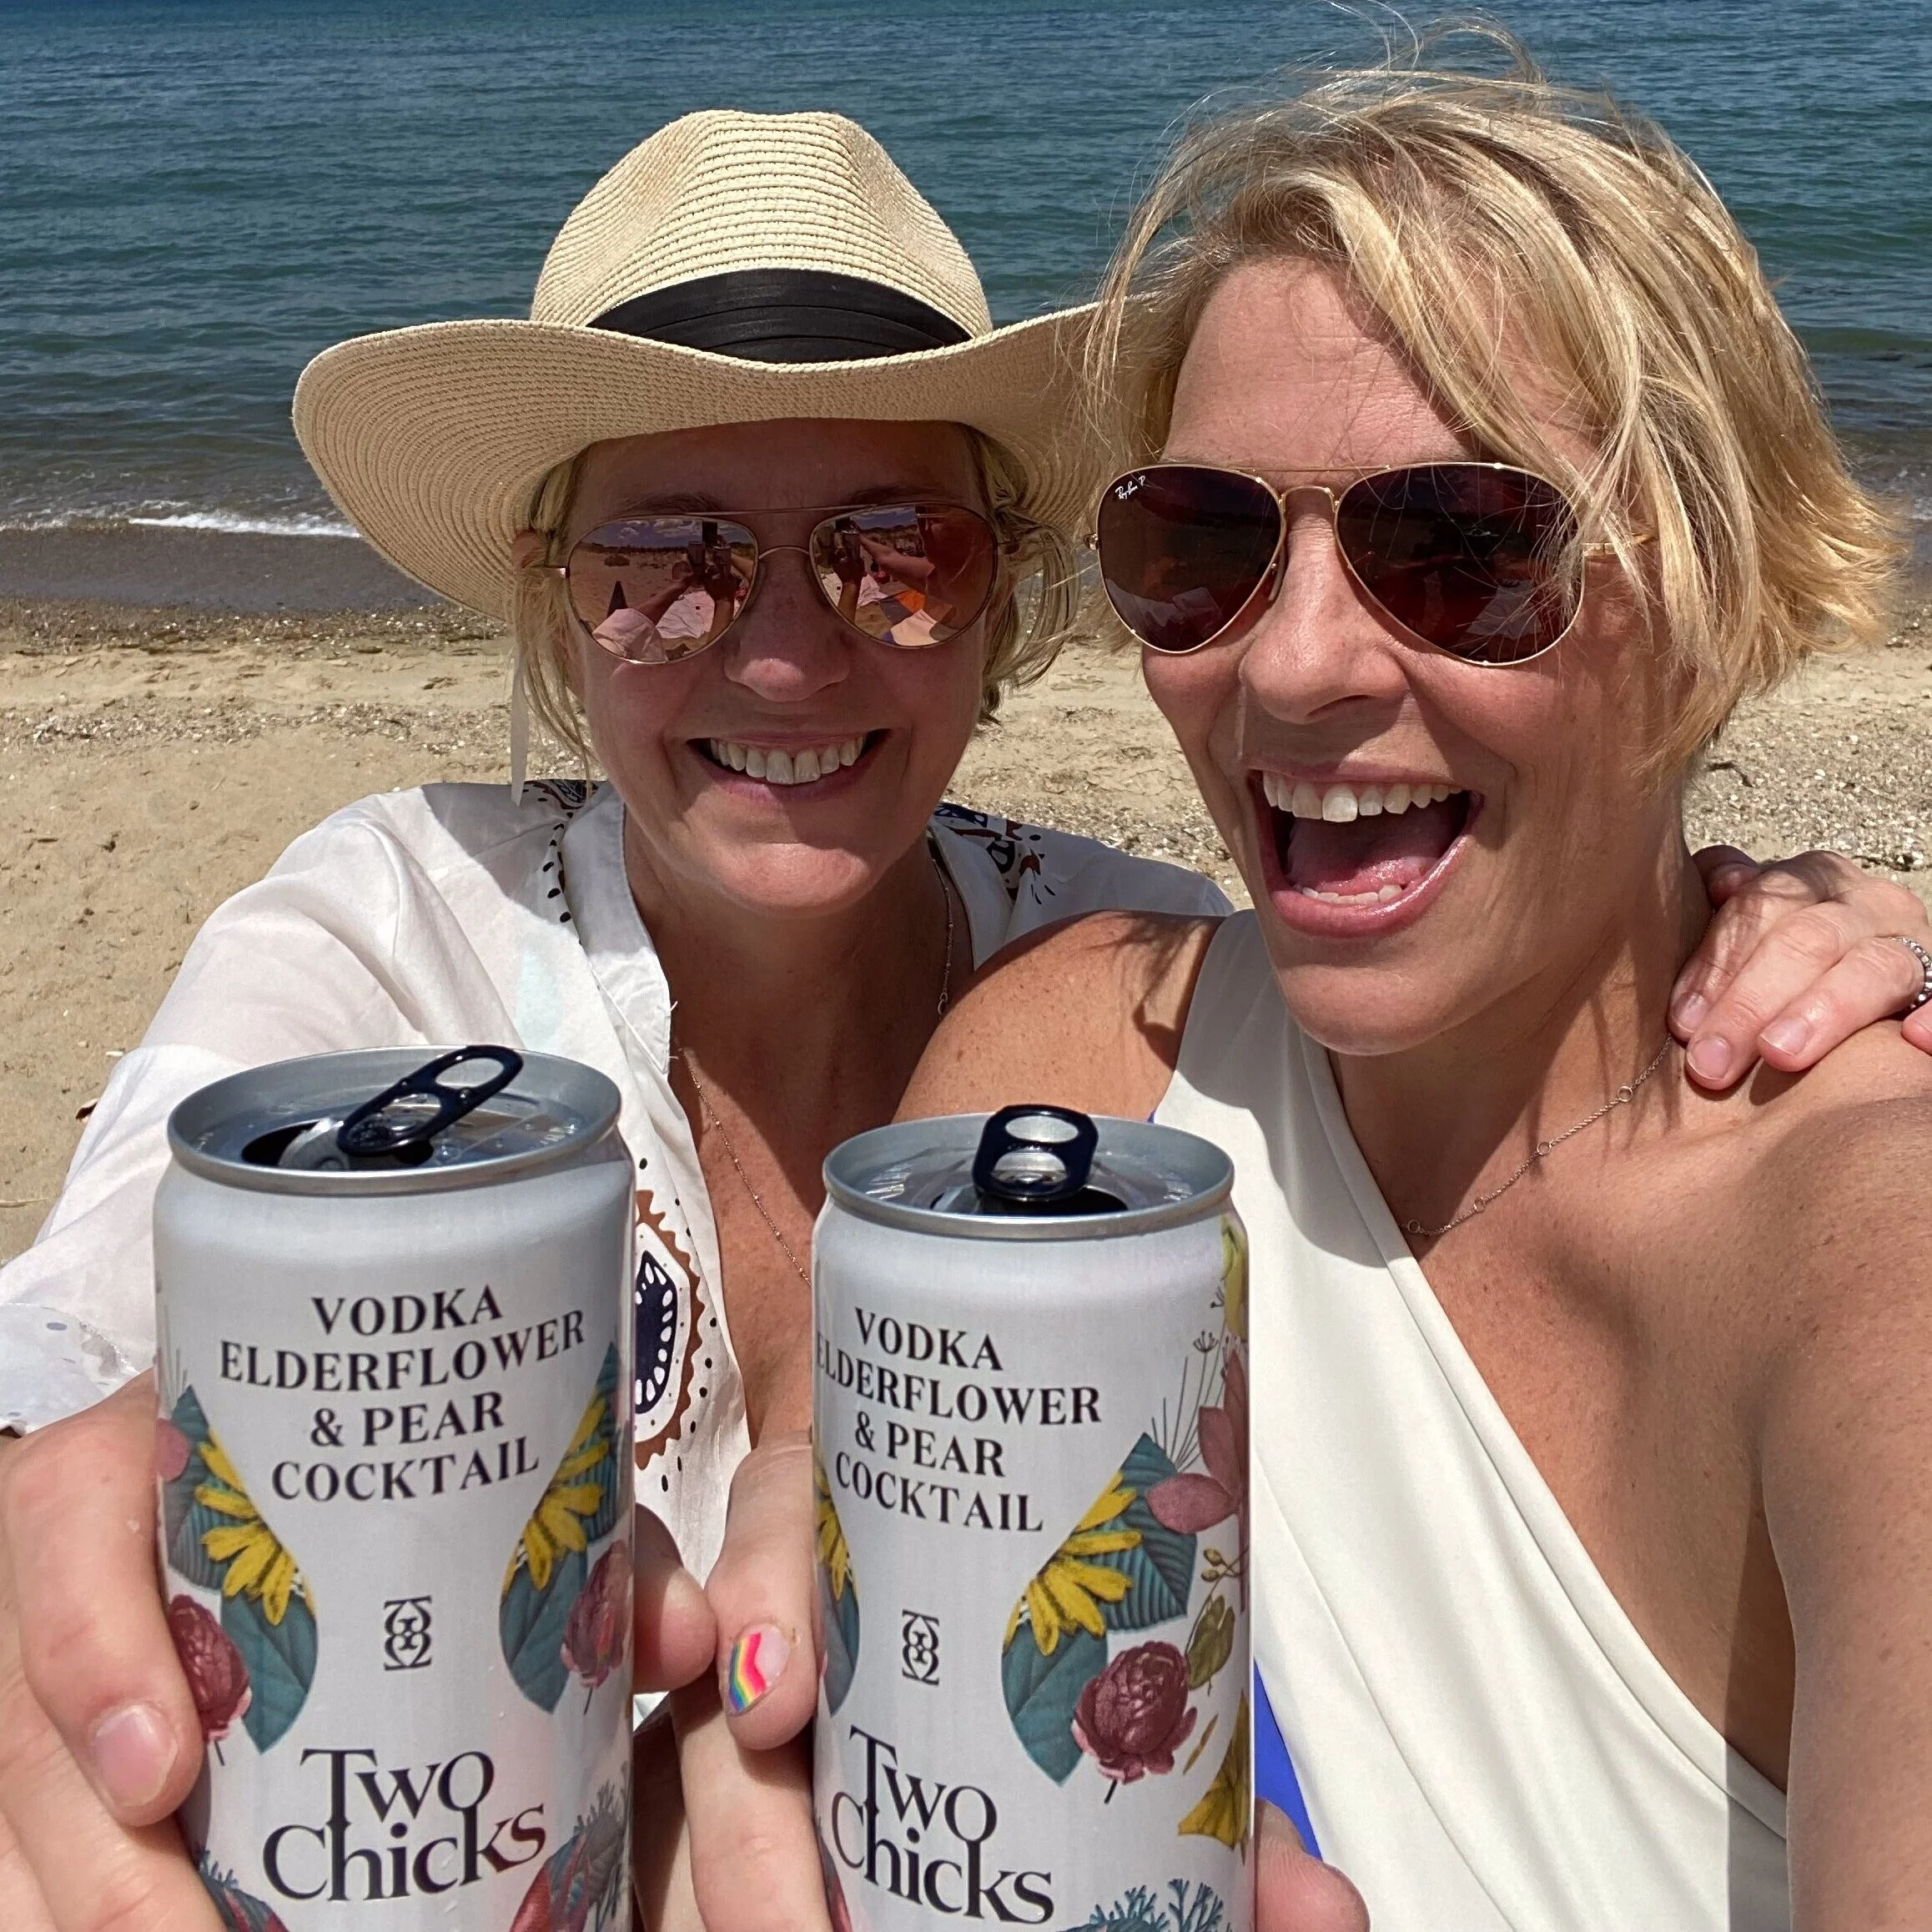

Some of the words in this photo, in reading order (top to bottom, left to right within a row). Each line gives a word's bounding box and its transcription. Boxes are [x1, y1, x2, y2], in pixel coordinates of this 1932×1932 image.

[311, 1284, 504, 1336] VODKA
[854, 1306, 1004, 1371] VODKA
[219, 1309, 585, 1391] ELDERFLOWER
[309, 1408, 344, 1447] &
[362, 1391, 505, 1446] PEAR
[854, 1411, 876, 1452] &
[887, 1421, 1006, 1477] PEAR
[271, 1436, 540, 1501] COCKTAIL
[835, 1451, 1044, 1532] COCKTAIL
[300, 1748, 495, 1824] Two
[848, 1724, 998, 1844] Two
[261, 1803, 546, 1902] Chicks
[831, 1791, 1054, 1925] Chicks
